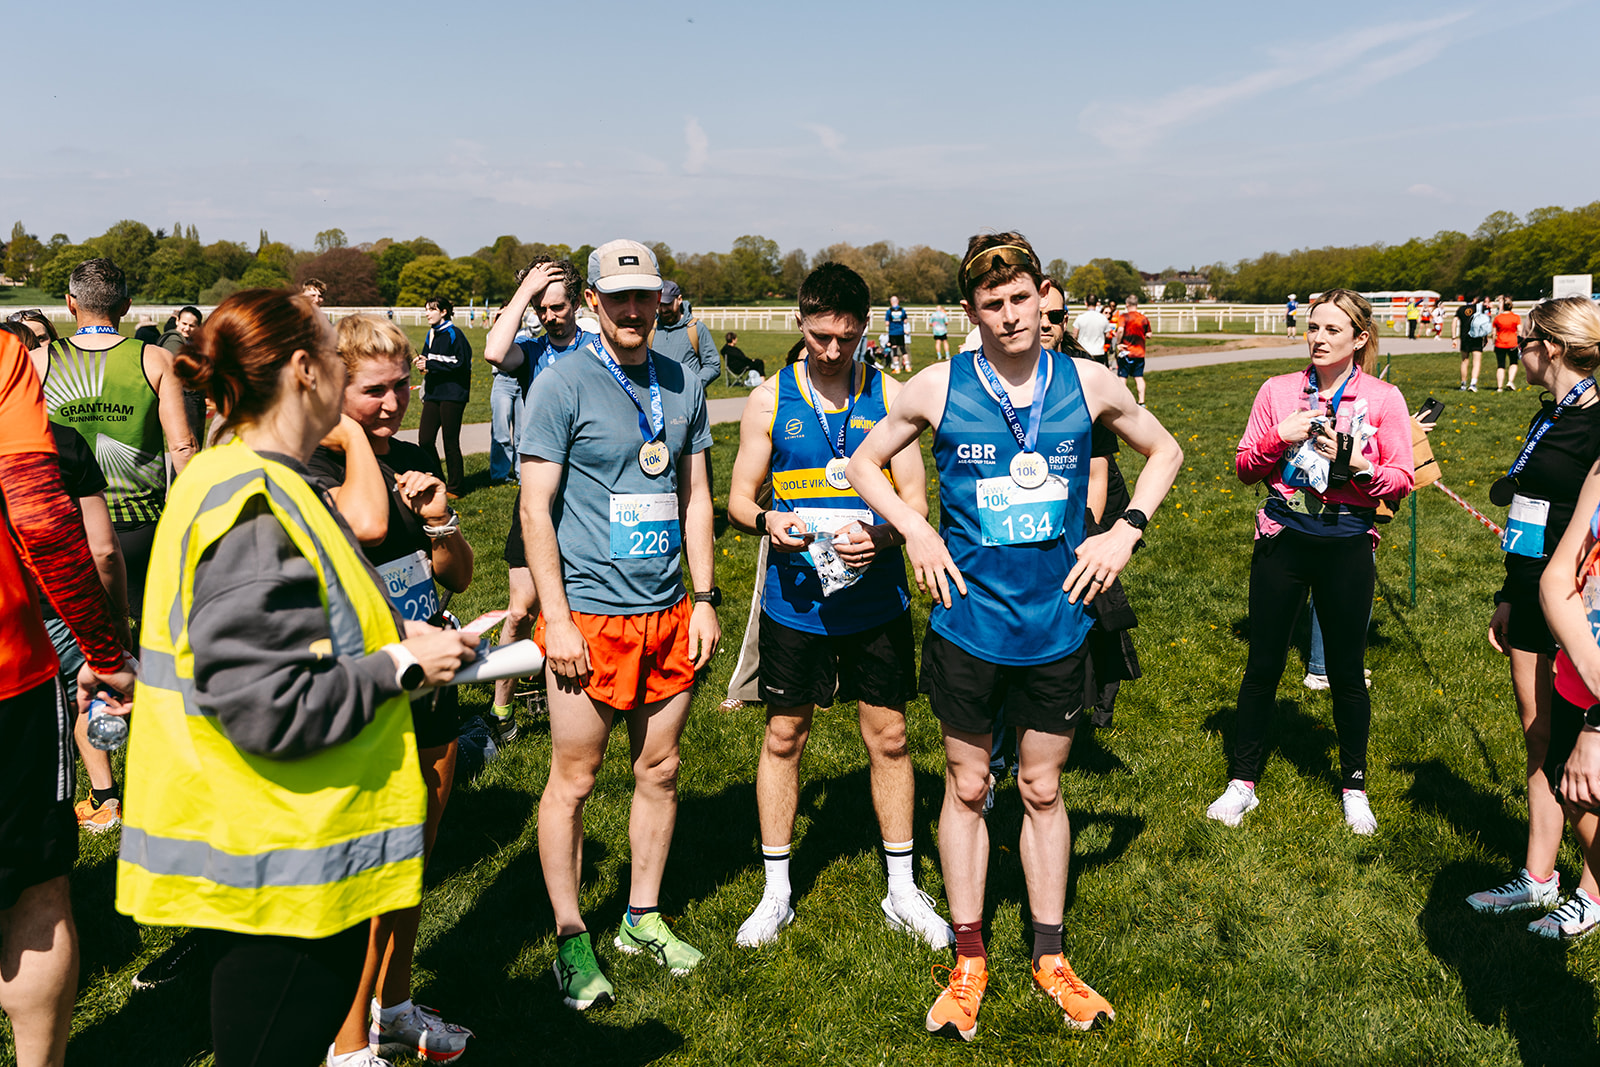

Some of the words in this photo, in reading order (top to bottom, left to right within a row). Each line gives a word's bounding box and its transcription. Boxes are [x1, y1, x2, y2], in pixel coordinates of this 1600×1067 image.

[608, 364, 628, 386] TEWV
[978, 358, 994, 380] TEWV
[60, 402, 134, 417] GRANTHAM
[1001, 397, 1017, 422] TEWV
[1012, 423, 1026, 444] 2026
[957, 443, 996, 460] GBR
[1512, 454, 1529, 475] TEWV
[1525, 438, 1537, 454] 10k
[1534, 422, 1550, 440] 2026
[644, 454, 661, 467] 10k
[1016, 467, 1037, 477] 10k
[983, 494, 1009, 507] 10k
[616, 510, 640, 522] 10k
[1002, 511, 1053, 541] 134
[629, 530, 670, 555] 226
[404, 589, 438, 621] 236
